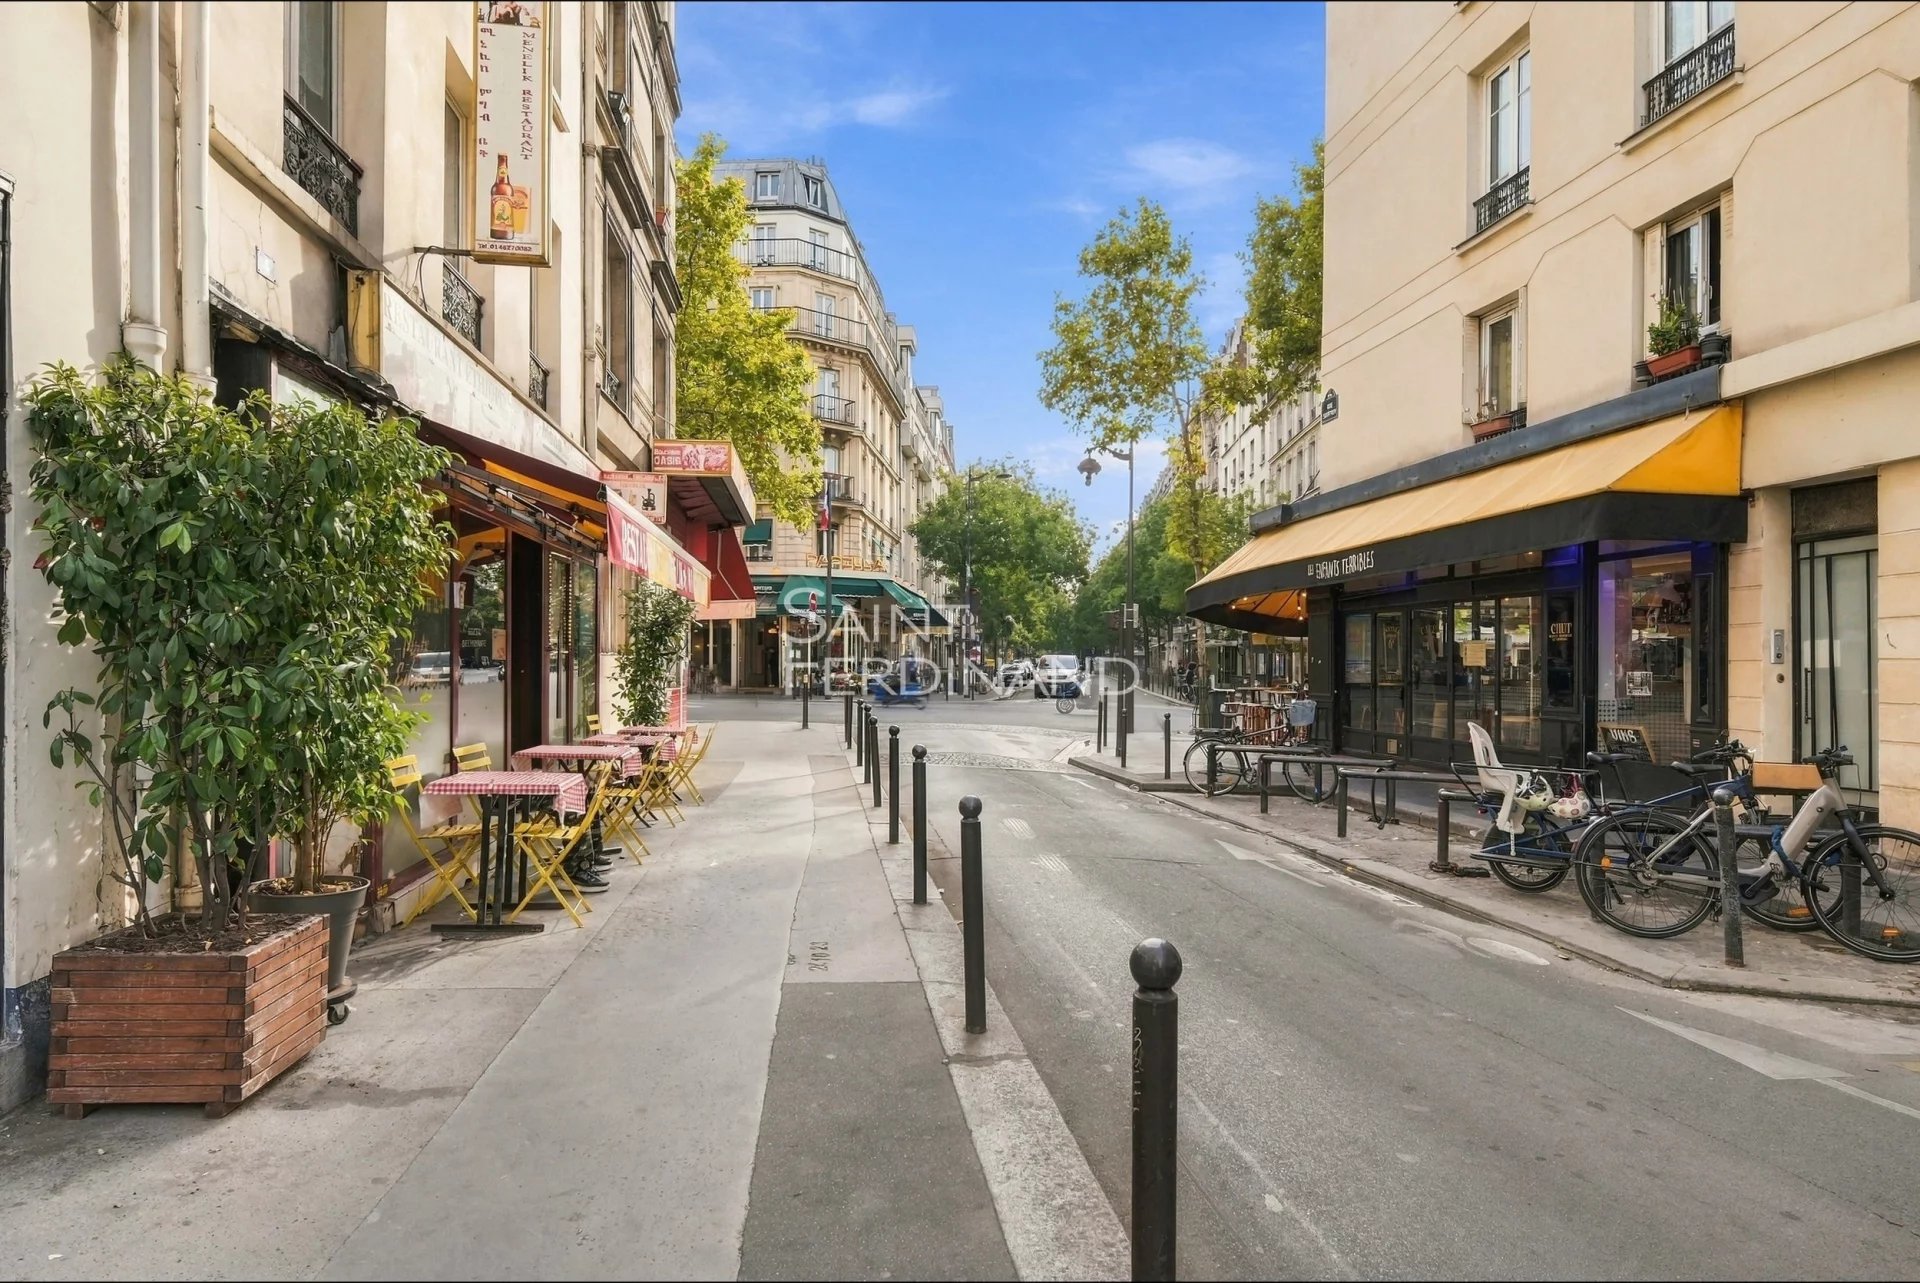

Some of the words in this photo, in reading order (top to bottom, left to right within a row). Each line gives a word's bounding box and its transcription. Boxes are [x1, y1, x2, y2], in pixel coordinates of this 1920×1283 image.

[522, 31, 535, 82] MENELIK
[520, 89, 533, 160] RESTAURANT
[1315, 559, 1340, 580] ENFANTS
[1341, 550, 1375, 575] TERRIBLES
